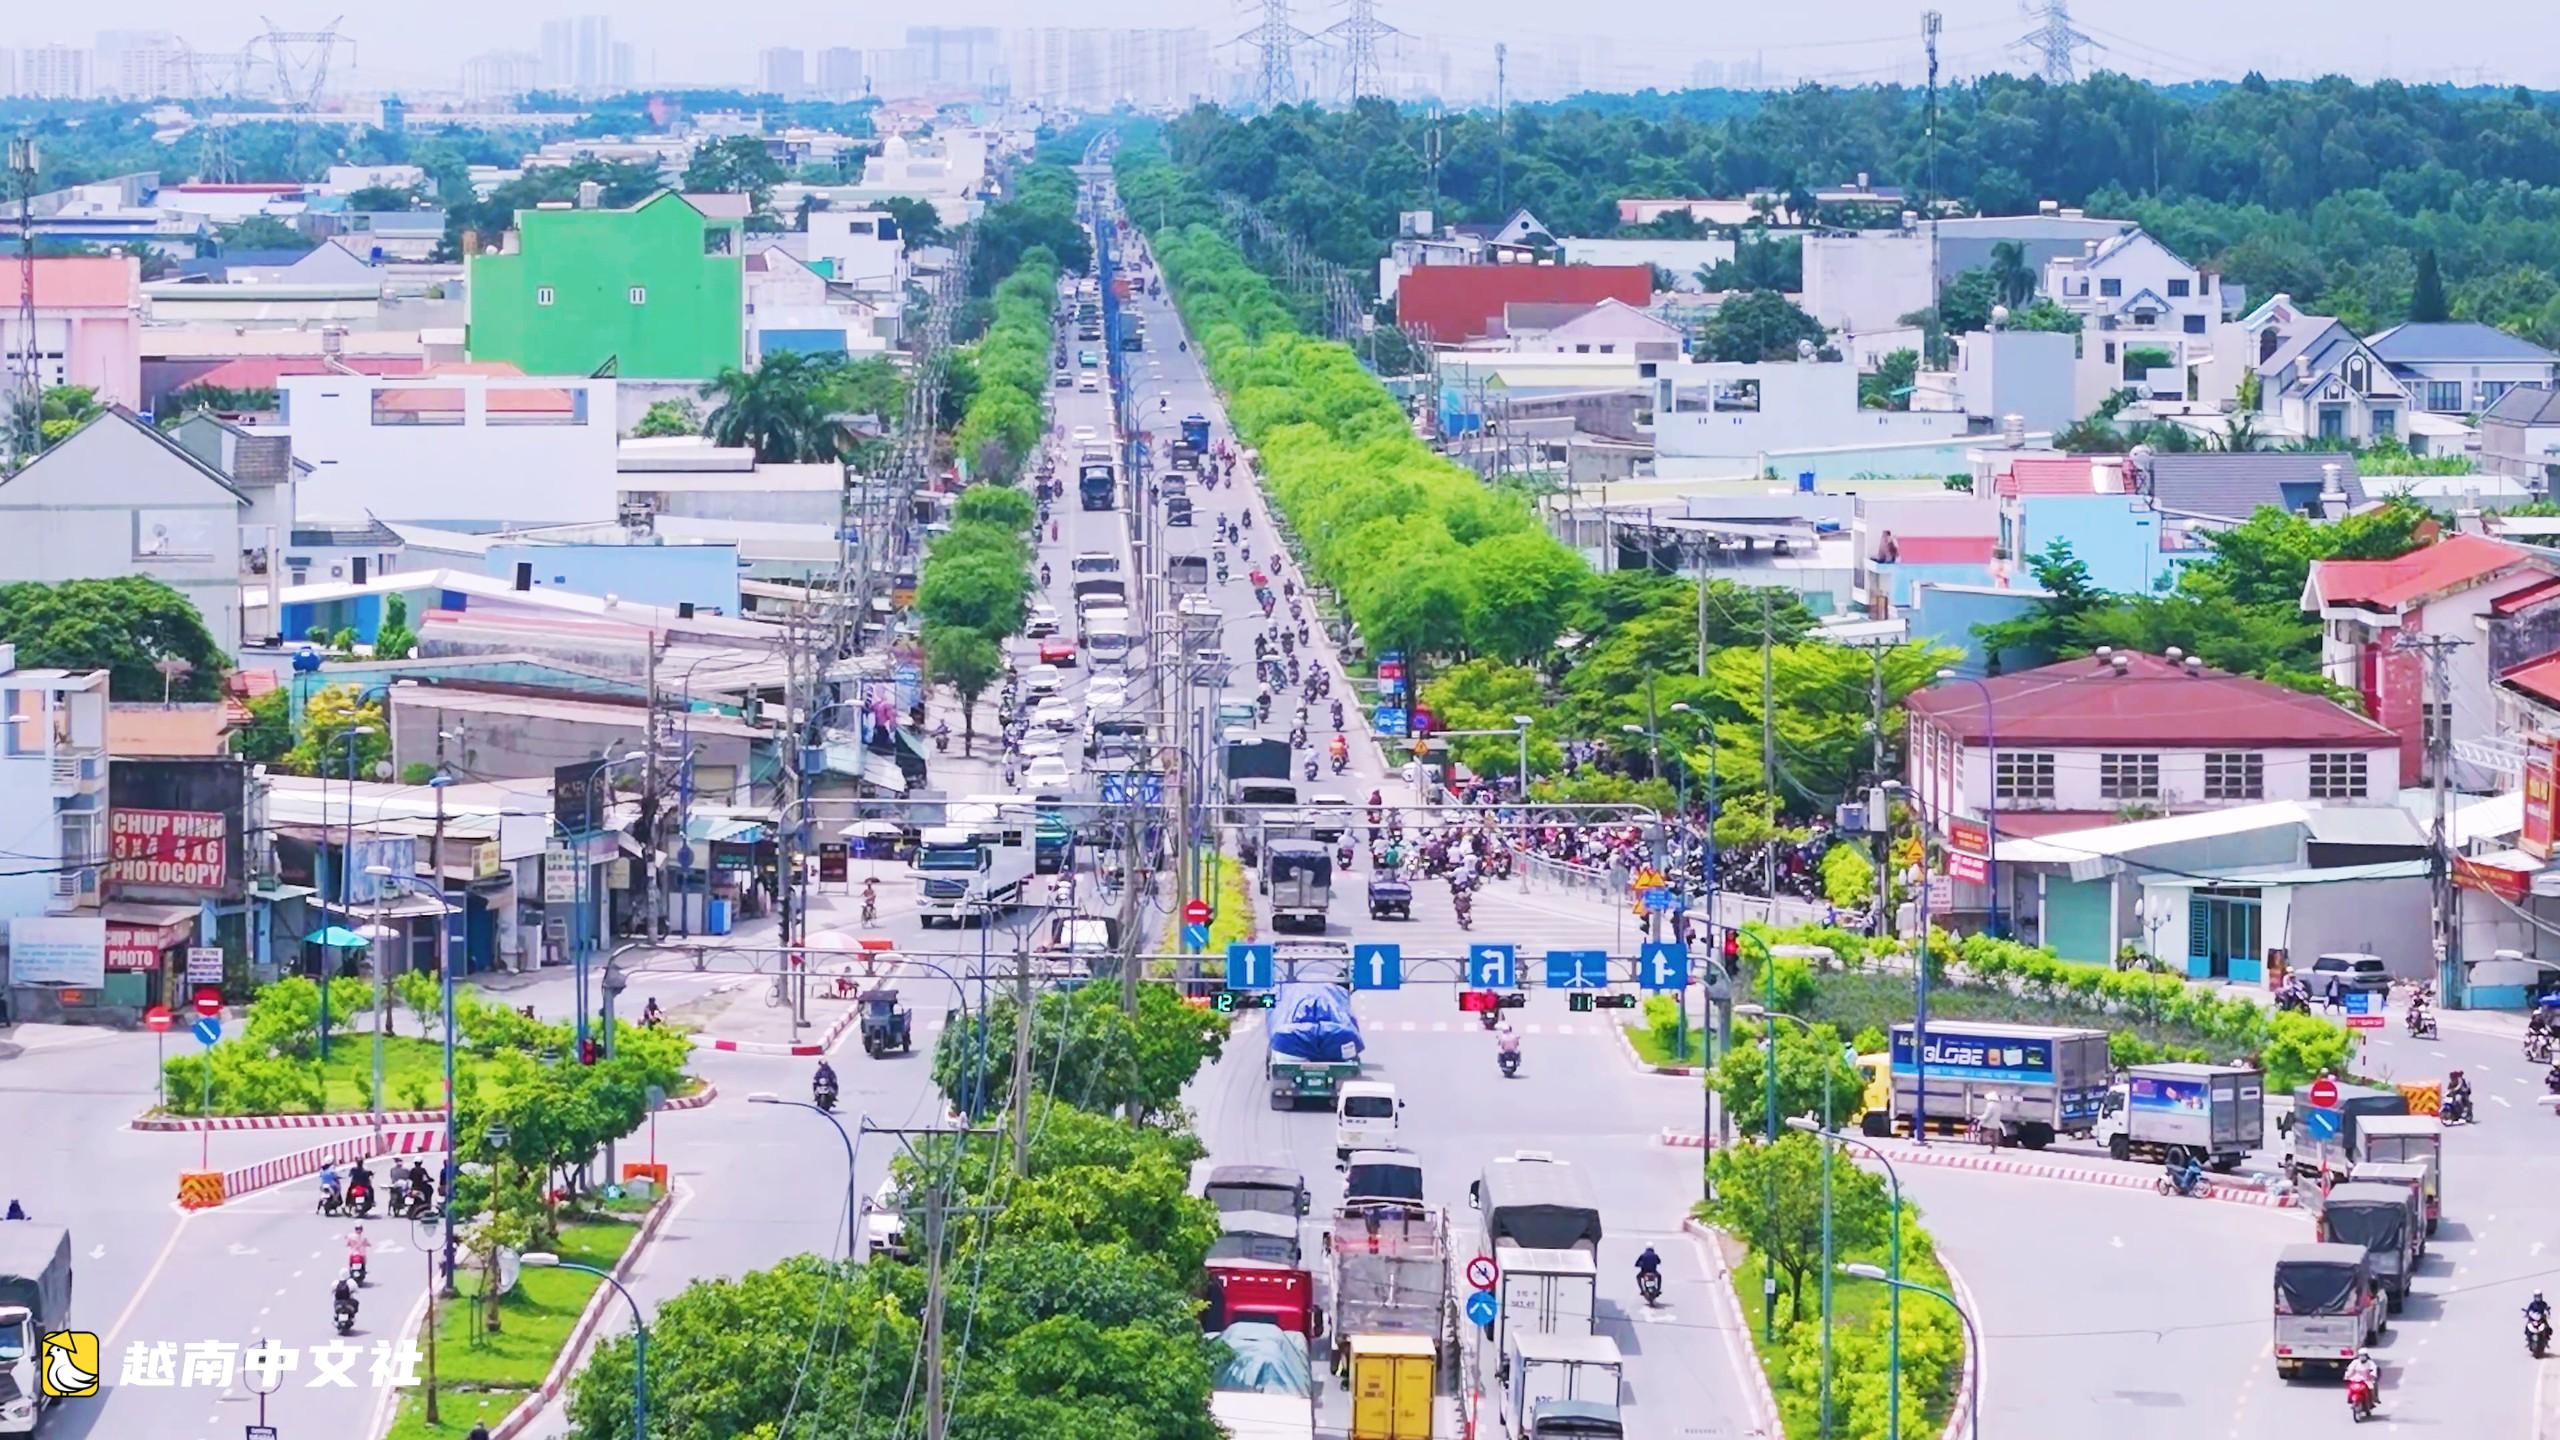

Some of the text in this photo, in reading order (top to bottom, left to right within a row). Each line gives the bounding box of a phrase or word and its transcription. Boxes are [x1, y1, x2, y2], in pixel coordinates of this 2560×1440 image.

[113, 812, 224, 839] CHỤP HÌNH
[115, 835, 127, 858] 3
[206, 841, 218, 863] 6
[110, 860, 221, 885] PHOTOCOPY
[108, 950, 154, 967] PHOTO
[1218, 993, 1232, 1011] 12
[1923, 1037, 1984, 1066] GLOBE
